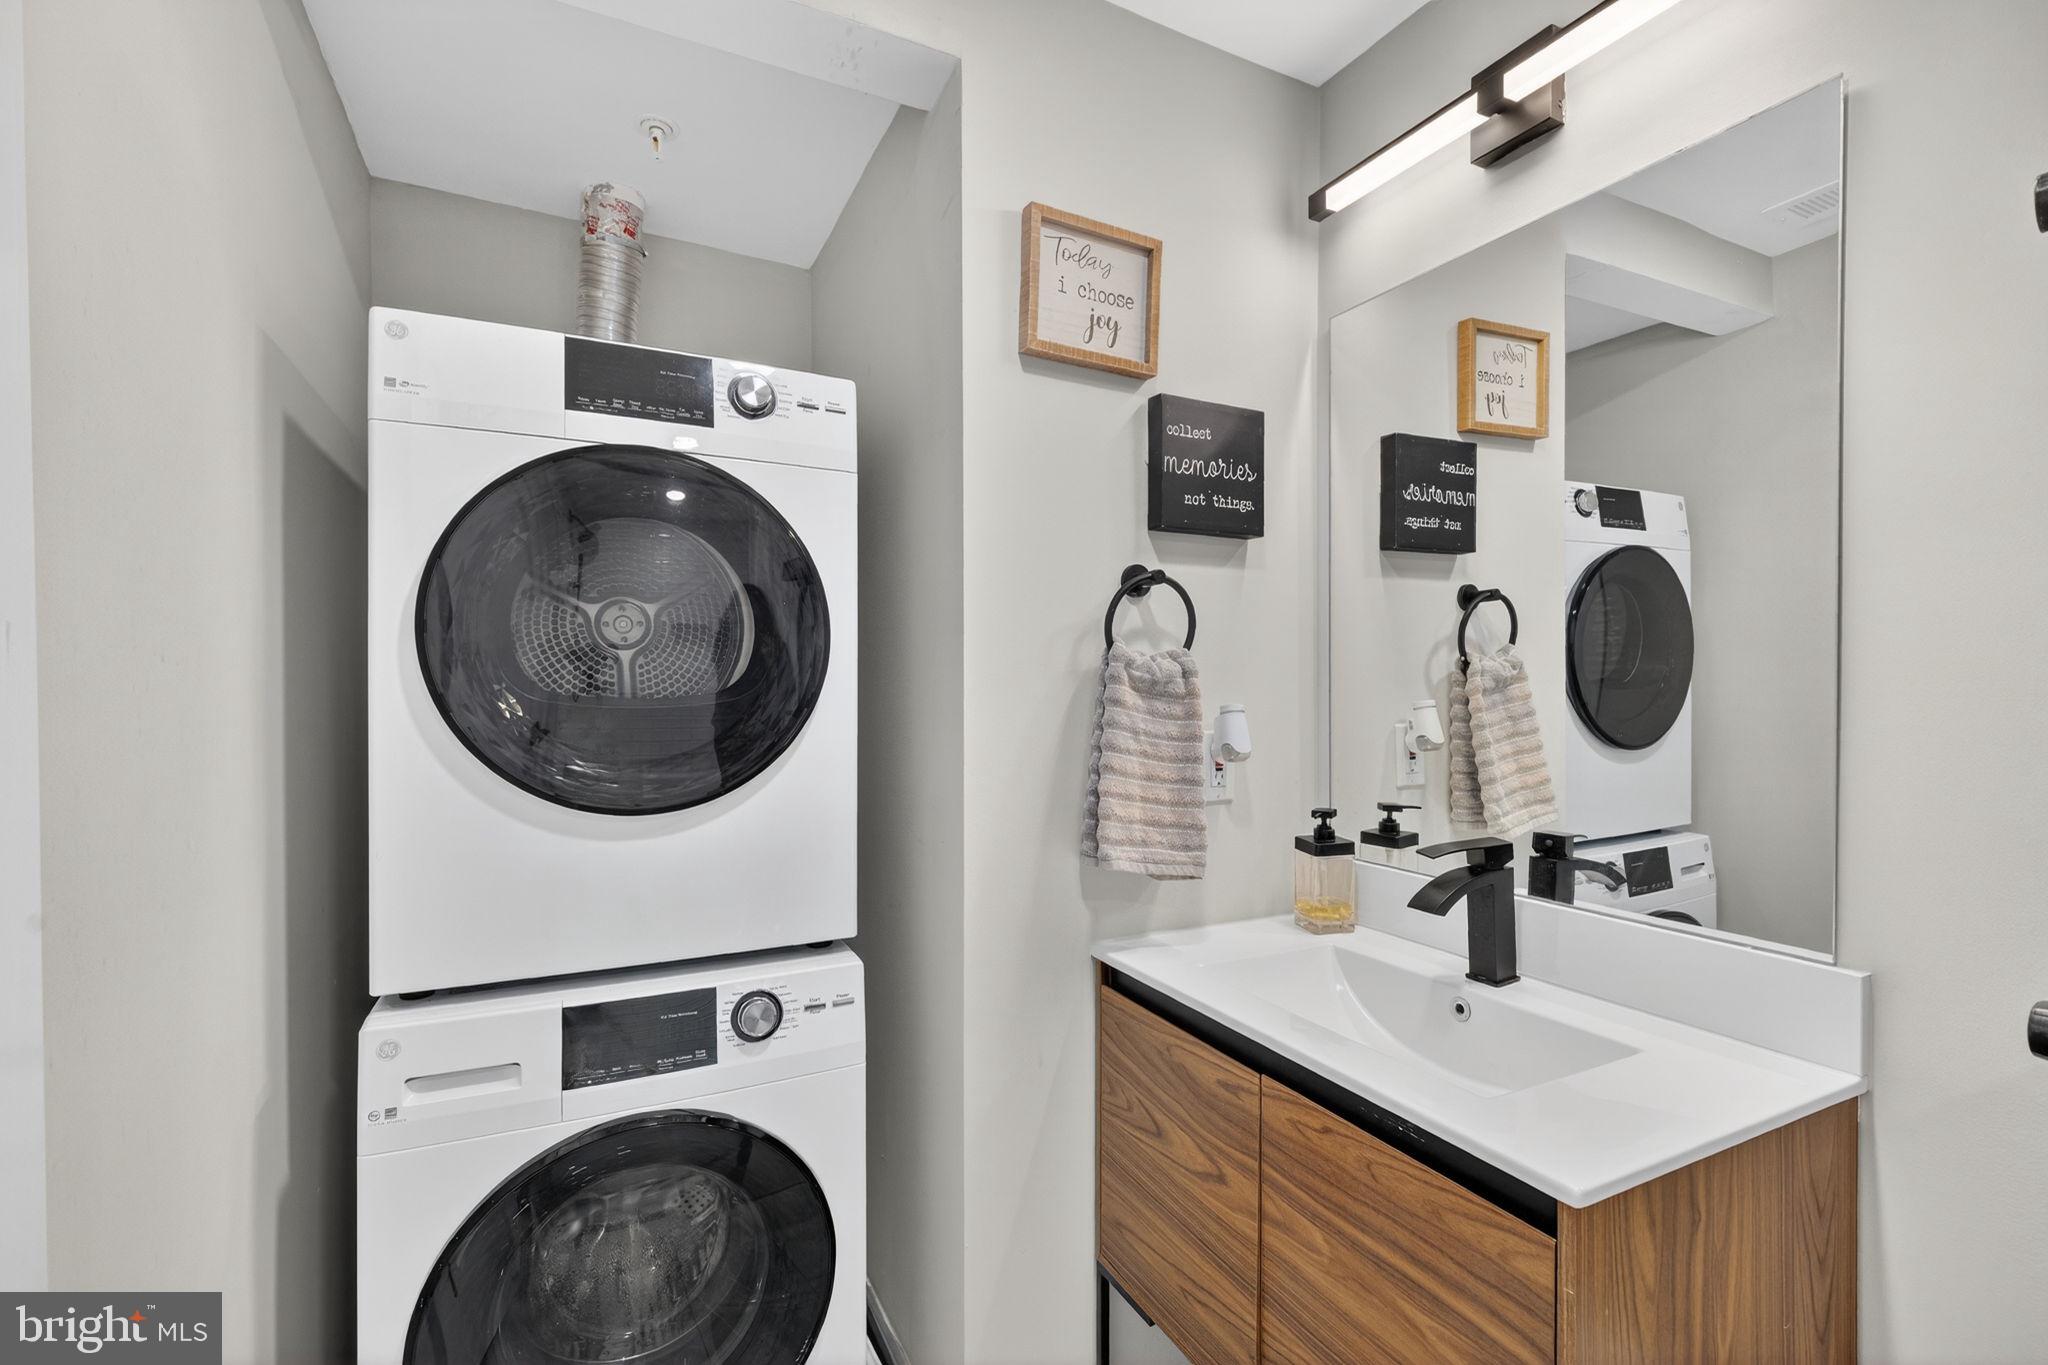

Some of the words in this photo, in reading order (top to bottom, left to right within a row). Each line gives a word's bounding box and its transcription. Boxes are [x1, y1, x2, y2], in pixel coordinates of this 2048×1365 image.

[1043, 234, 1115, 279] Today
[1057, 275, 1067, 294] i
[1077, 282, 1135, 310] choose
[1082, 308, 1122, 348] joy
[1166, 422, 1212, 441] collect
[1163, 454, 1257, 482] memories
[1184, 491, 1206, 506] not
[1212, 494, 1255, 513] things.
